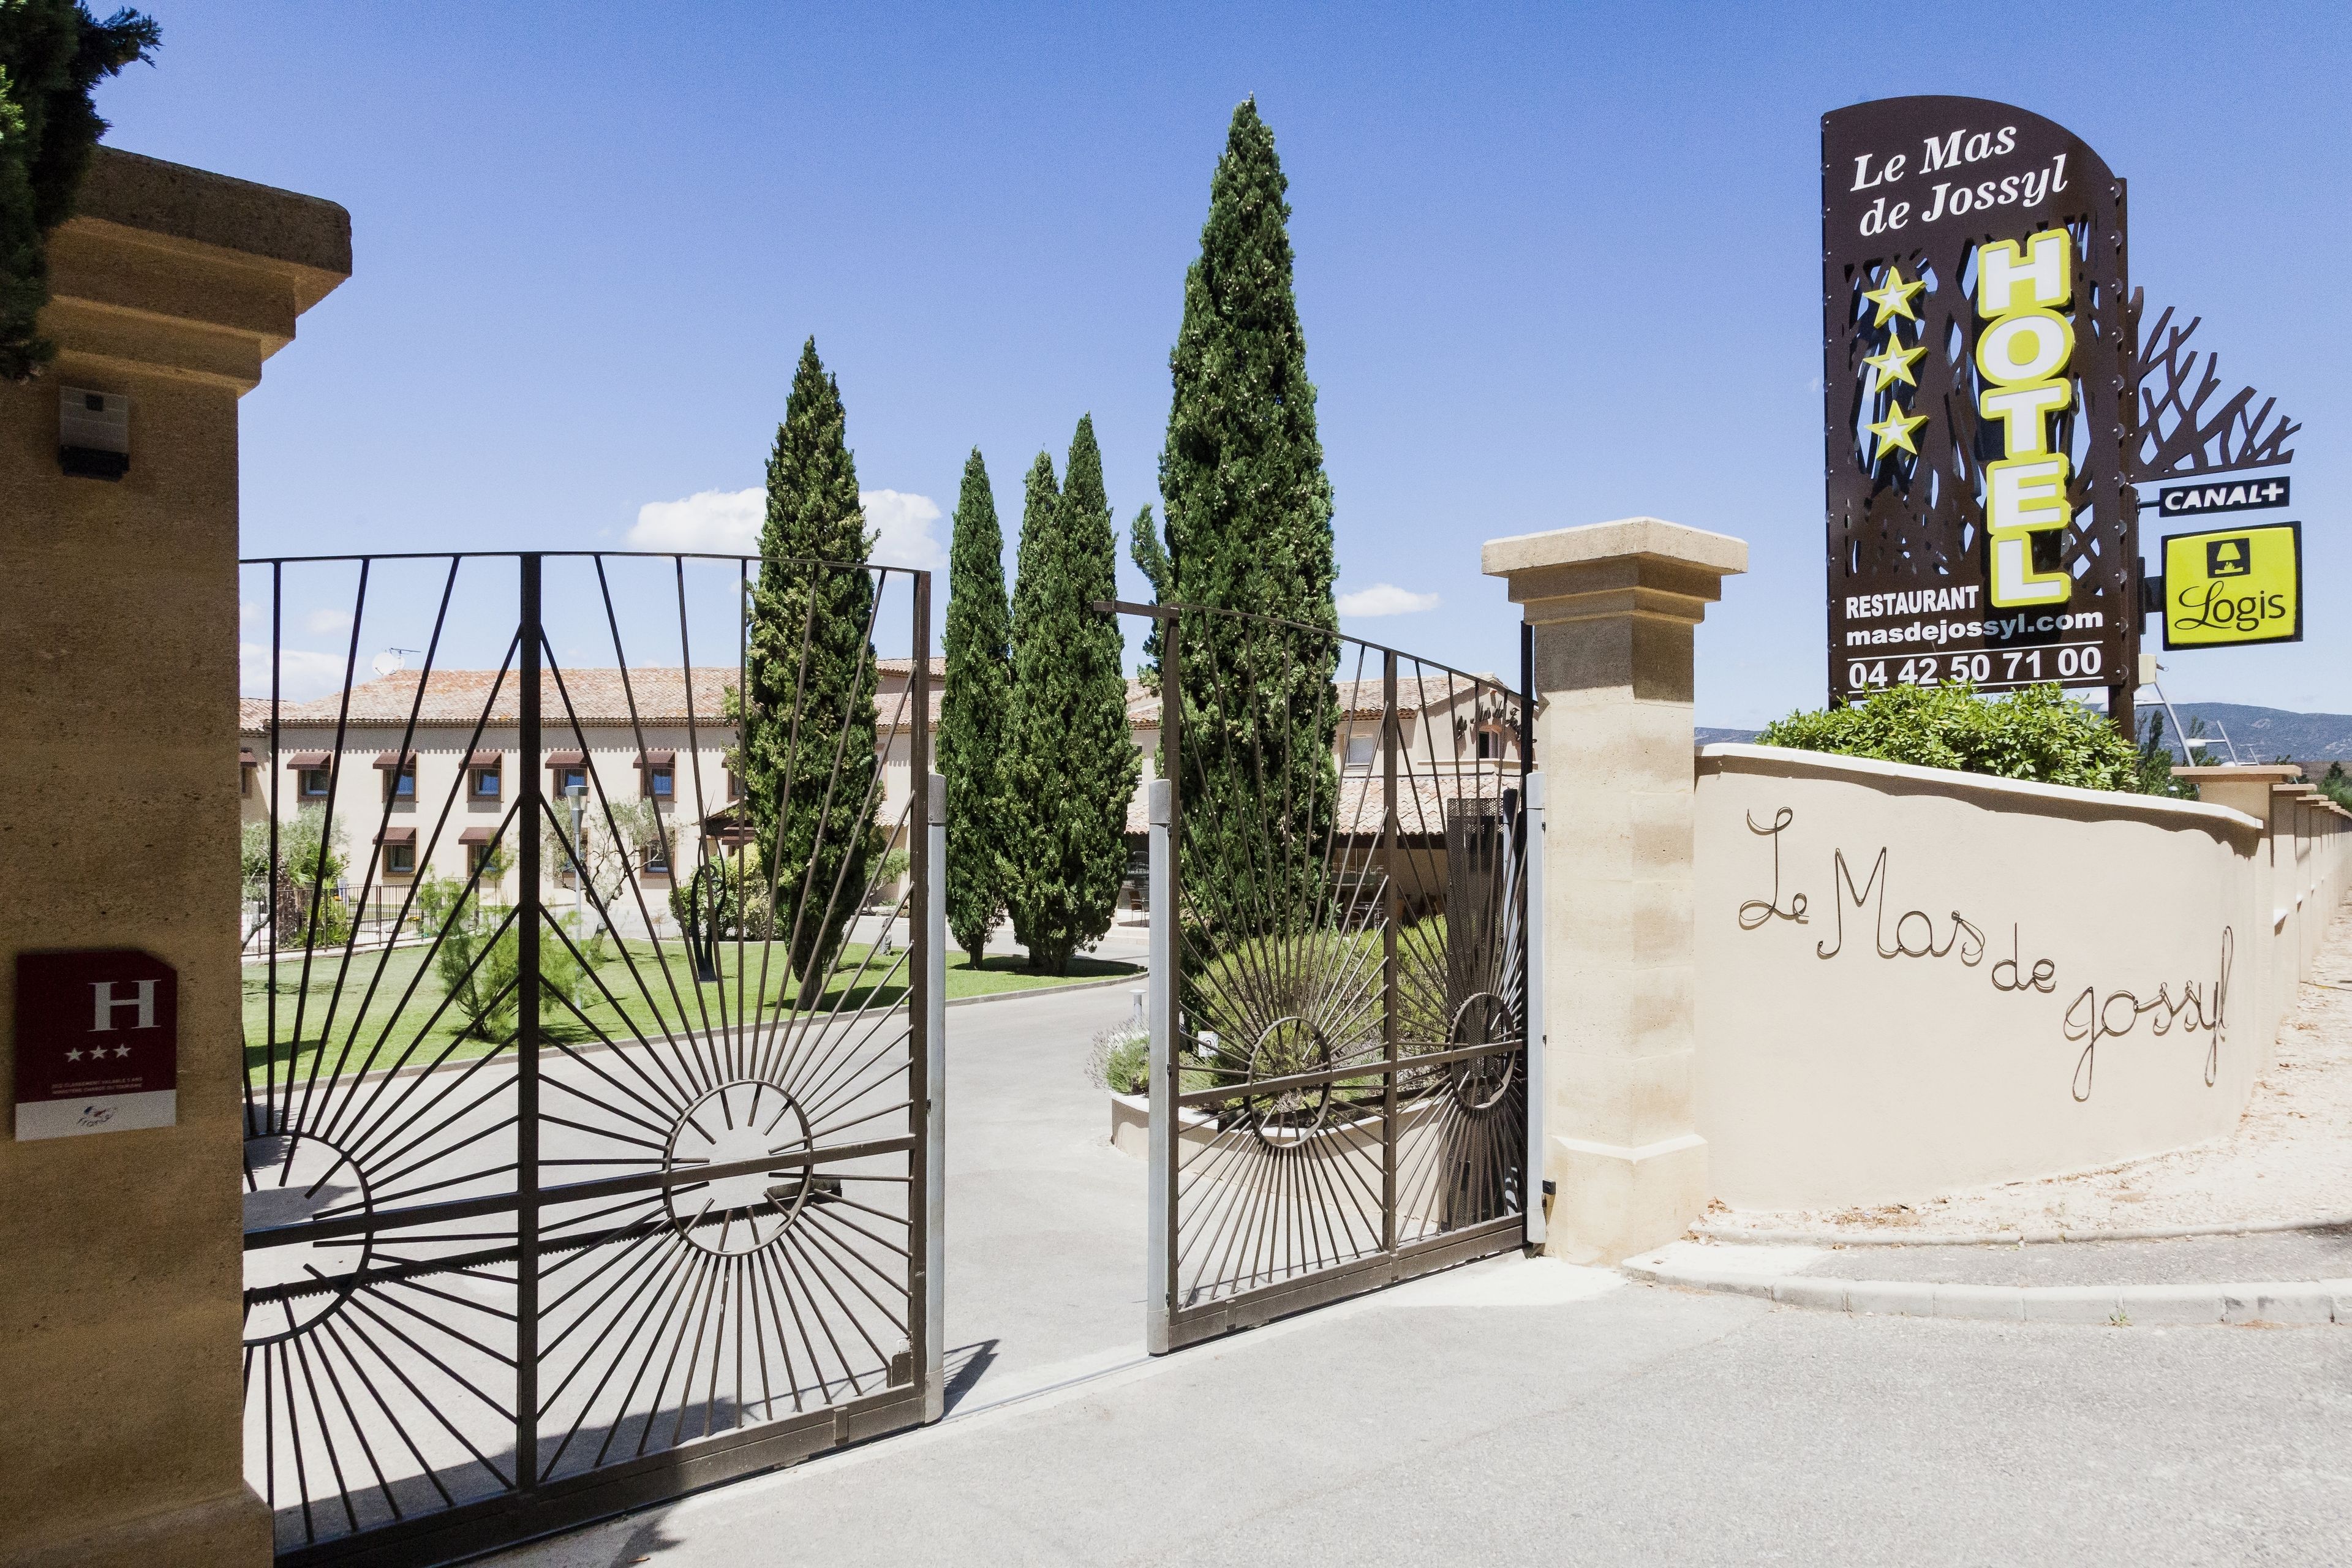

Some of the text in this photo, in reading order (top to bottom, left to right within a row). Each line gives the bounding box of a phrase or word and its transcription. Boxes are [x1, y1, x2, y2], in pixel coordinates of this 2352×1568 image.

[1850, 126, 2016, 191] Le Mas
[1860, 153, 2068, 236] de Jossyl
[1977, 229, 2074, 606] HOTEL
[2165, 482, 2283, 510] CANAL+
[1846, 586, 1979, 619] RESTAURANT
[2174, 581, 2286, 631] Logis
[1847, 612, 2103, 646] masdejossyl.com
[1849, 646, 2101, 688] 04 42 50 71 00
[1739, 807, 1985, 965] Le Mas
[1992, 922, 2057, 991] de
[88, 979, 161, 1031] H
